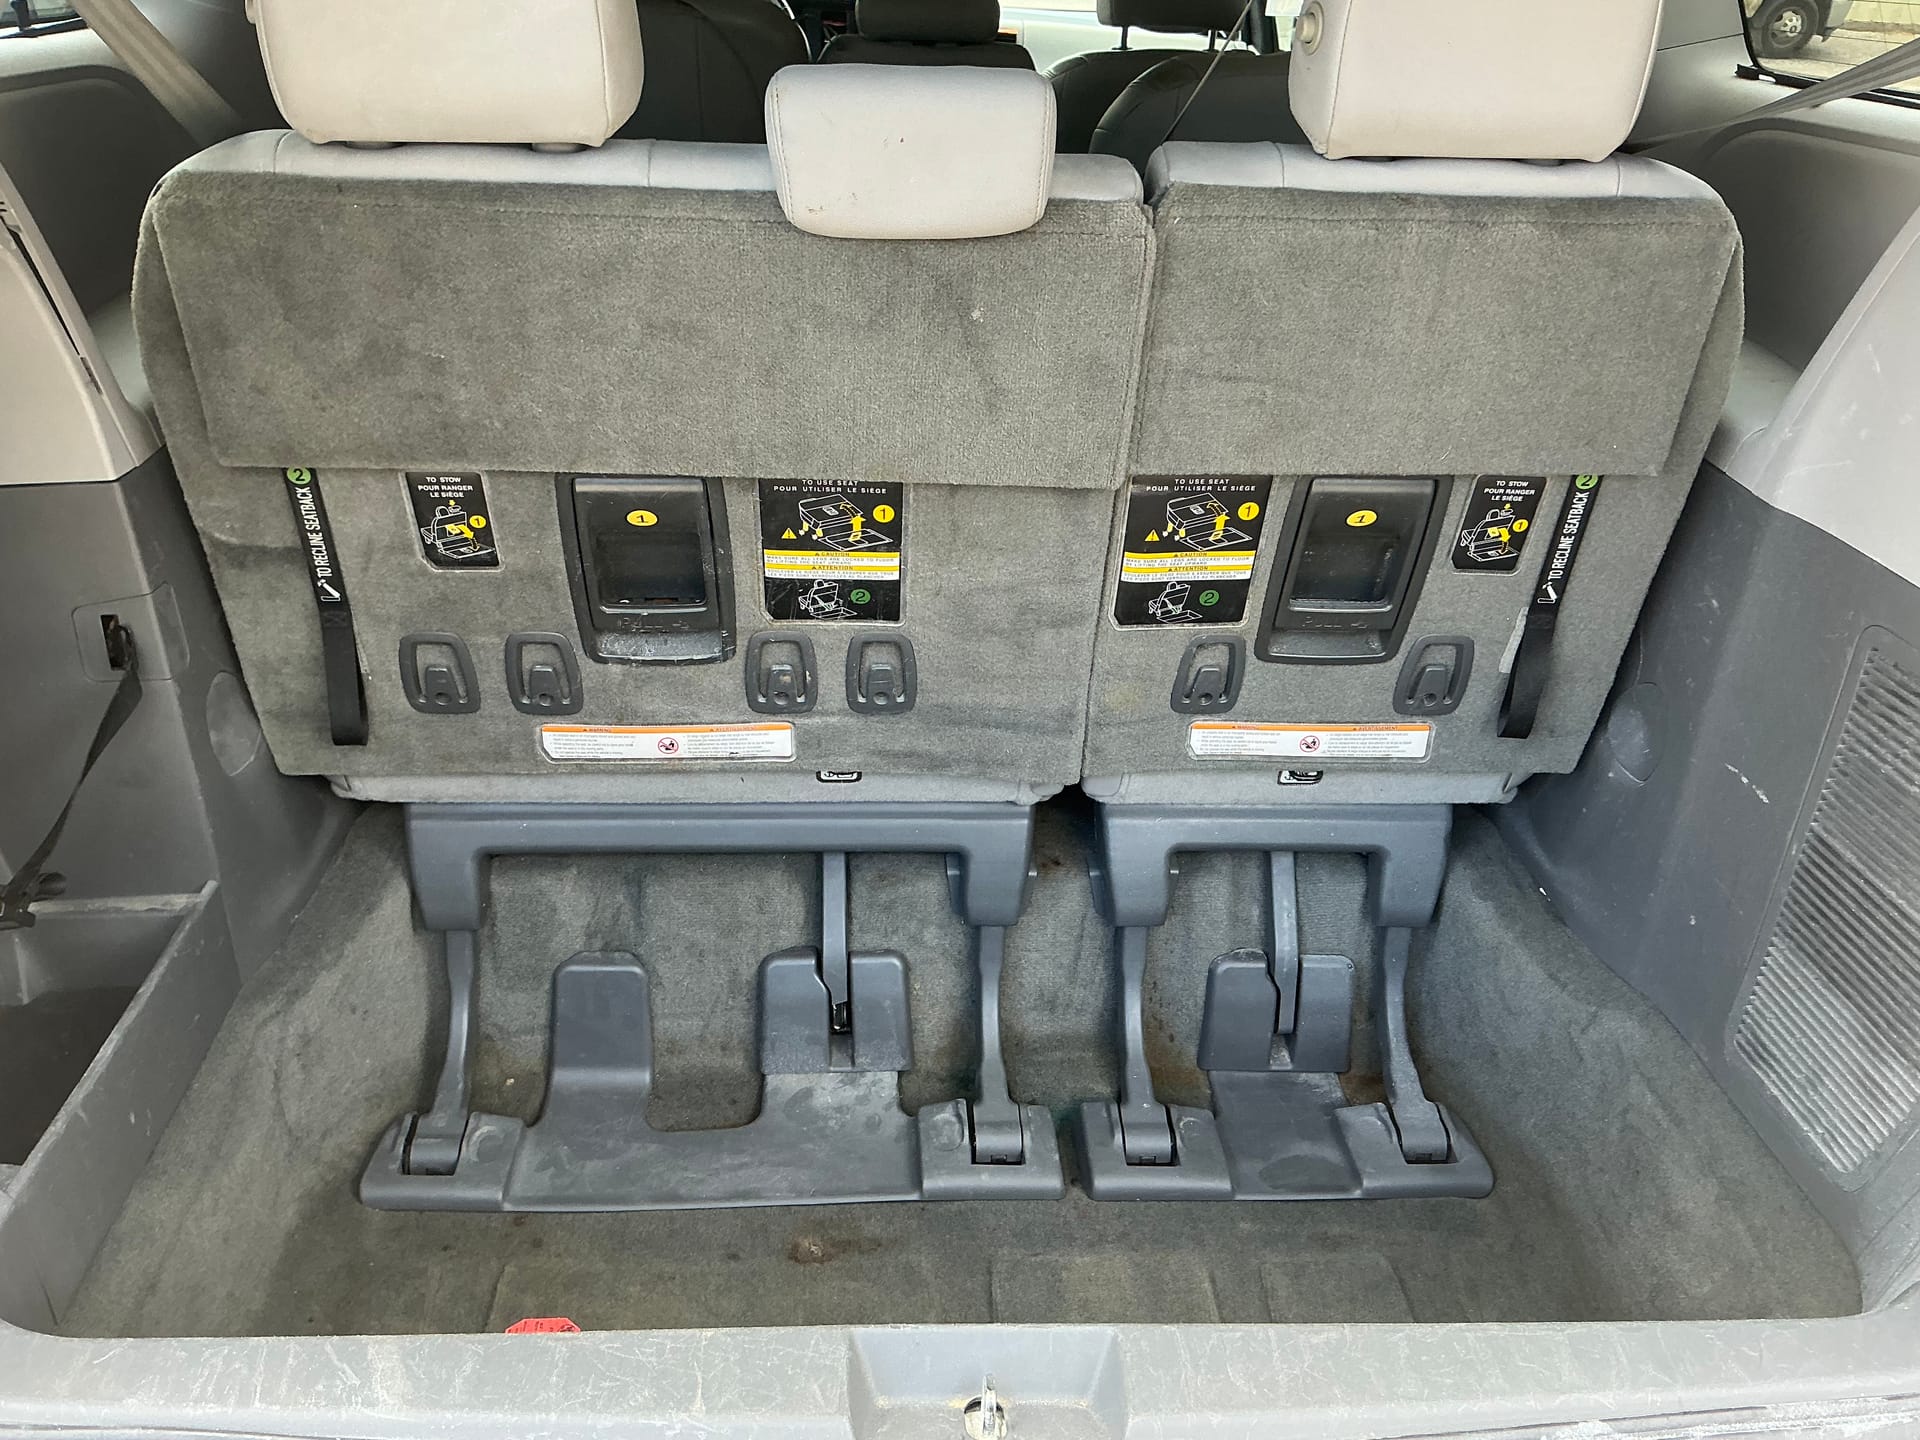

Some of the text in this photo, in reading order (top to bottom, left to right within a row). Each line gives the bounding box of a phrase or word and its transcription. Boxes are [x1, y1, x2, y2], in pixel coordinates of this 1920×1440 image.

[293, 468, 305, 481] 2
[1581, 475, 1591, 487] 2
[295, 487, 333, 578] TO RECLINE SEATBACK
[1547, 492, 1590, 580] TO RECLINE SEATBACK
[855, 592, 866, 602] 2
[1204, 593, 1215, 603] 2
